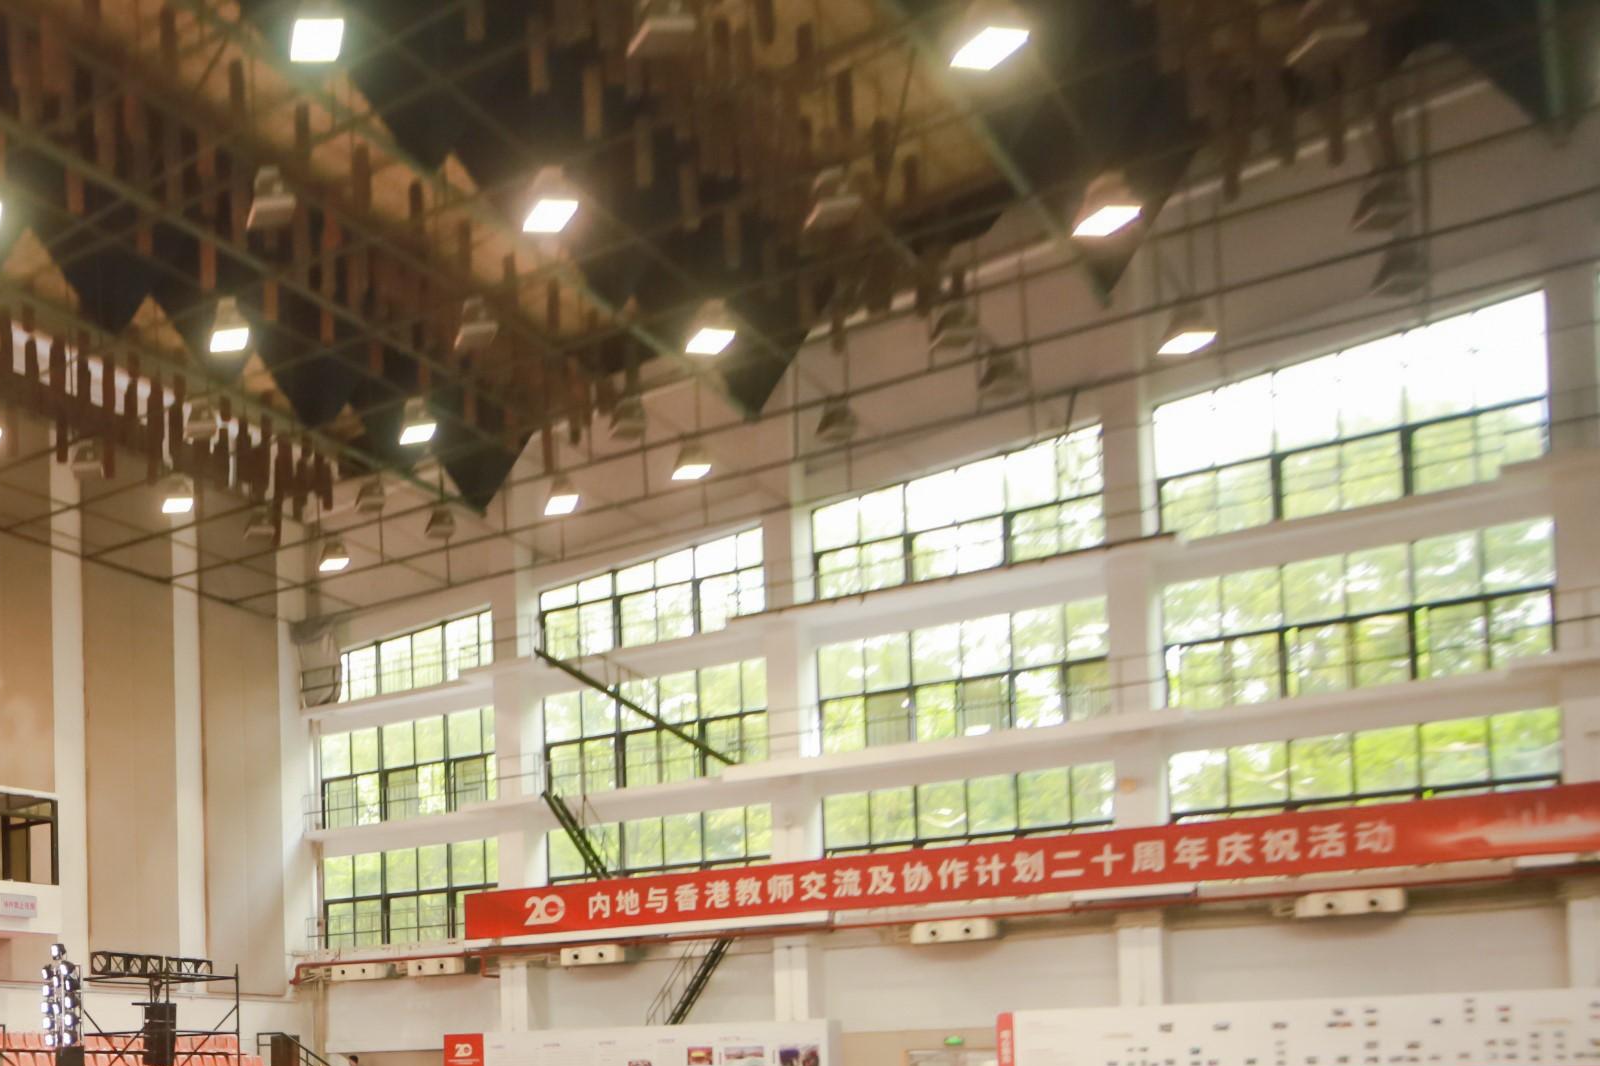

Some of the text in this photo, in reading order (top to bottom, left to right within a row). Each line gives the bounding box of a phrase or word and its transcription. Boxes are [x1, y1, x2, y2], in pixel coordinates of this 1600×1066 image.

[524, 819, 1395, 927] 20 内地与香港教师交流及协作计划二十周年庆祝活动
